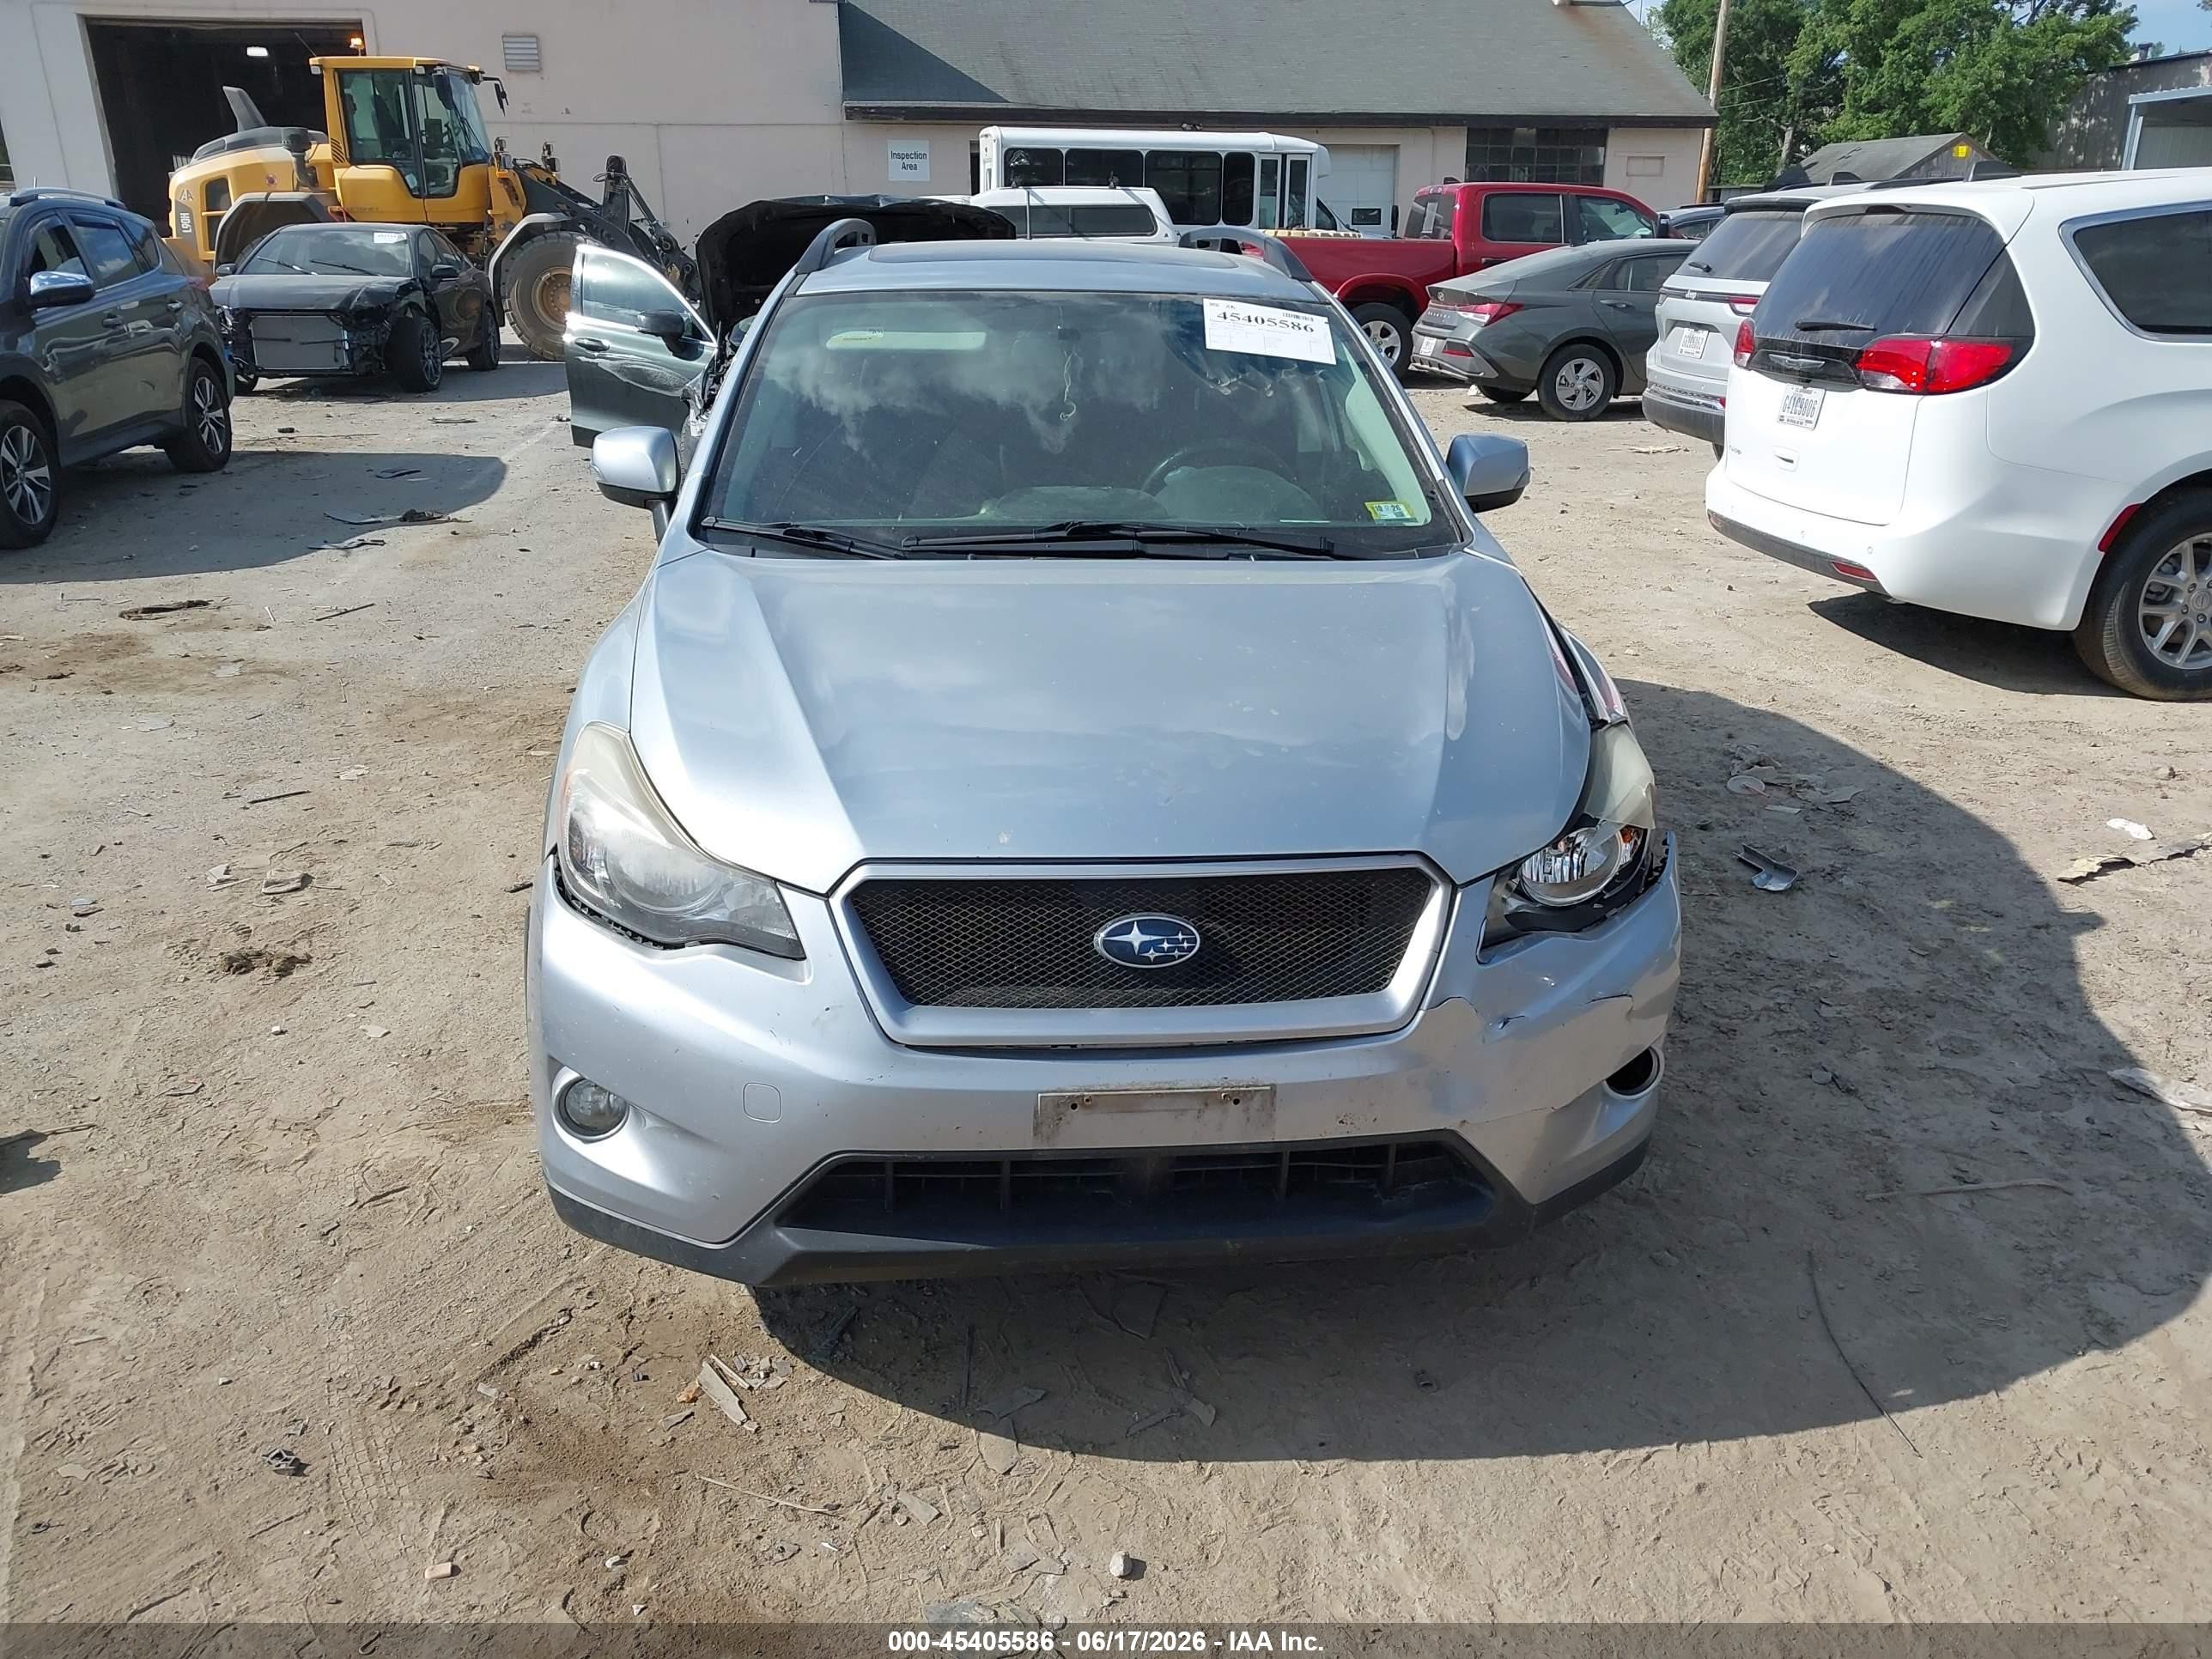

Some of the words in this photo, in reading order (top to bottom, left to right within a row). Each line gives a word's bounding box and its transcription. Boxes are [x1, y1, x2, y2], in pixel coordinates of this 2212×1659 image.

[890, 150, 927, 161] Inspection
[901, 161, 918, 171] Area
[179, 212, 192, 234] L90H
[1217, 311, 1315, 333] 45405586
